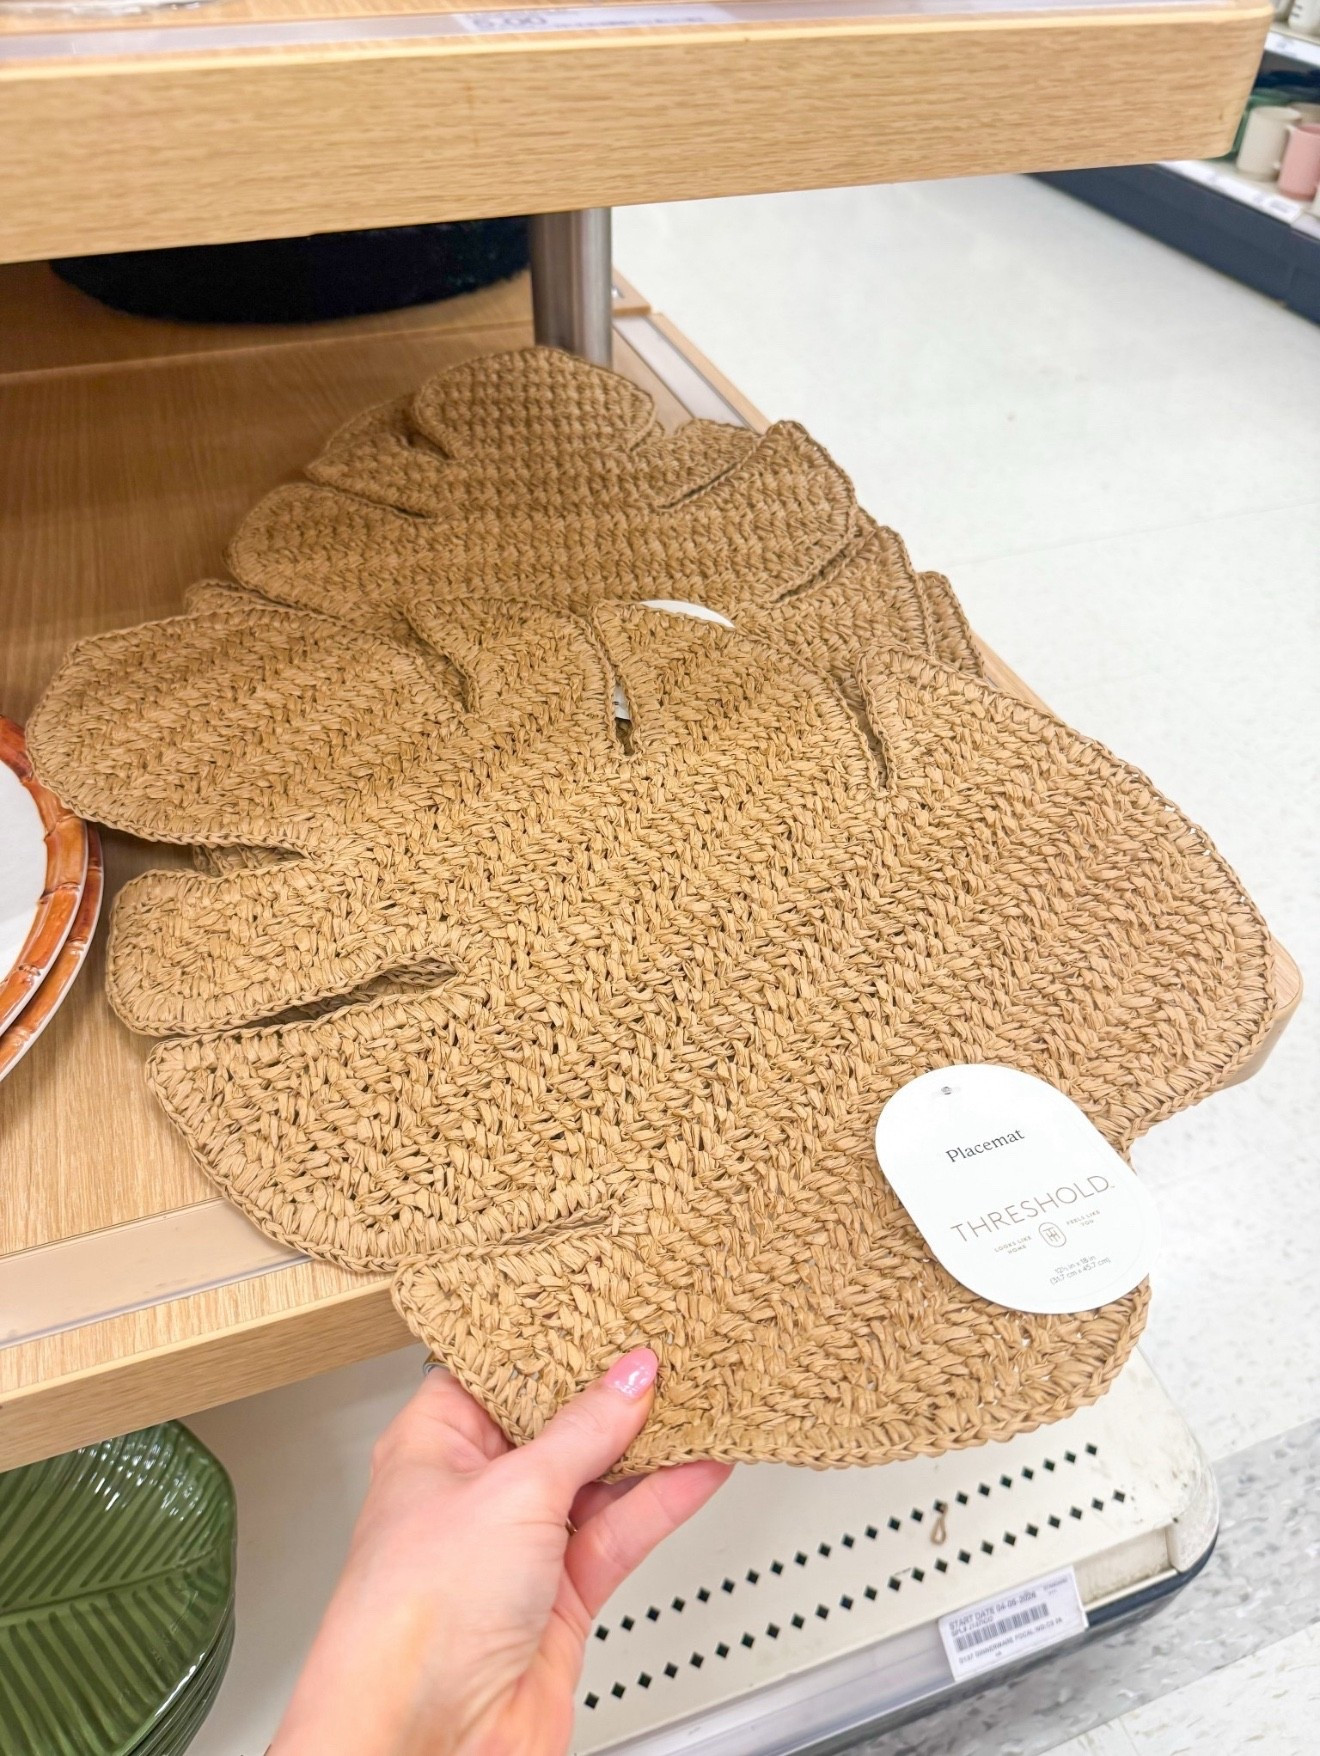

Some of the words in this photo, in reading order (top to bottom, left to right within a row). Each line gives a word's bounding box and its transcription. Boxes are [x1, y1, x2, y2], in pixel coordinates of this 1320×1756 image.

[945, 1129, 1025, 1163] Placemat
[950, 1175, 1109, 1242] THRESHOLD
[994, 1240, 1016, 1252] LOOKS
[1017, 1235, 1032, 1245] LIKE
[1008, 1244, 1027, 1254] HOME
[949, 1613, 974, 1630] START
[974, 1606, 995, 1620] DATE
